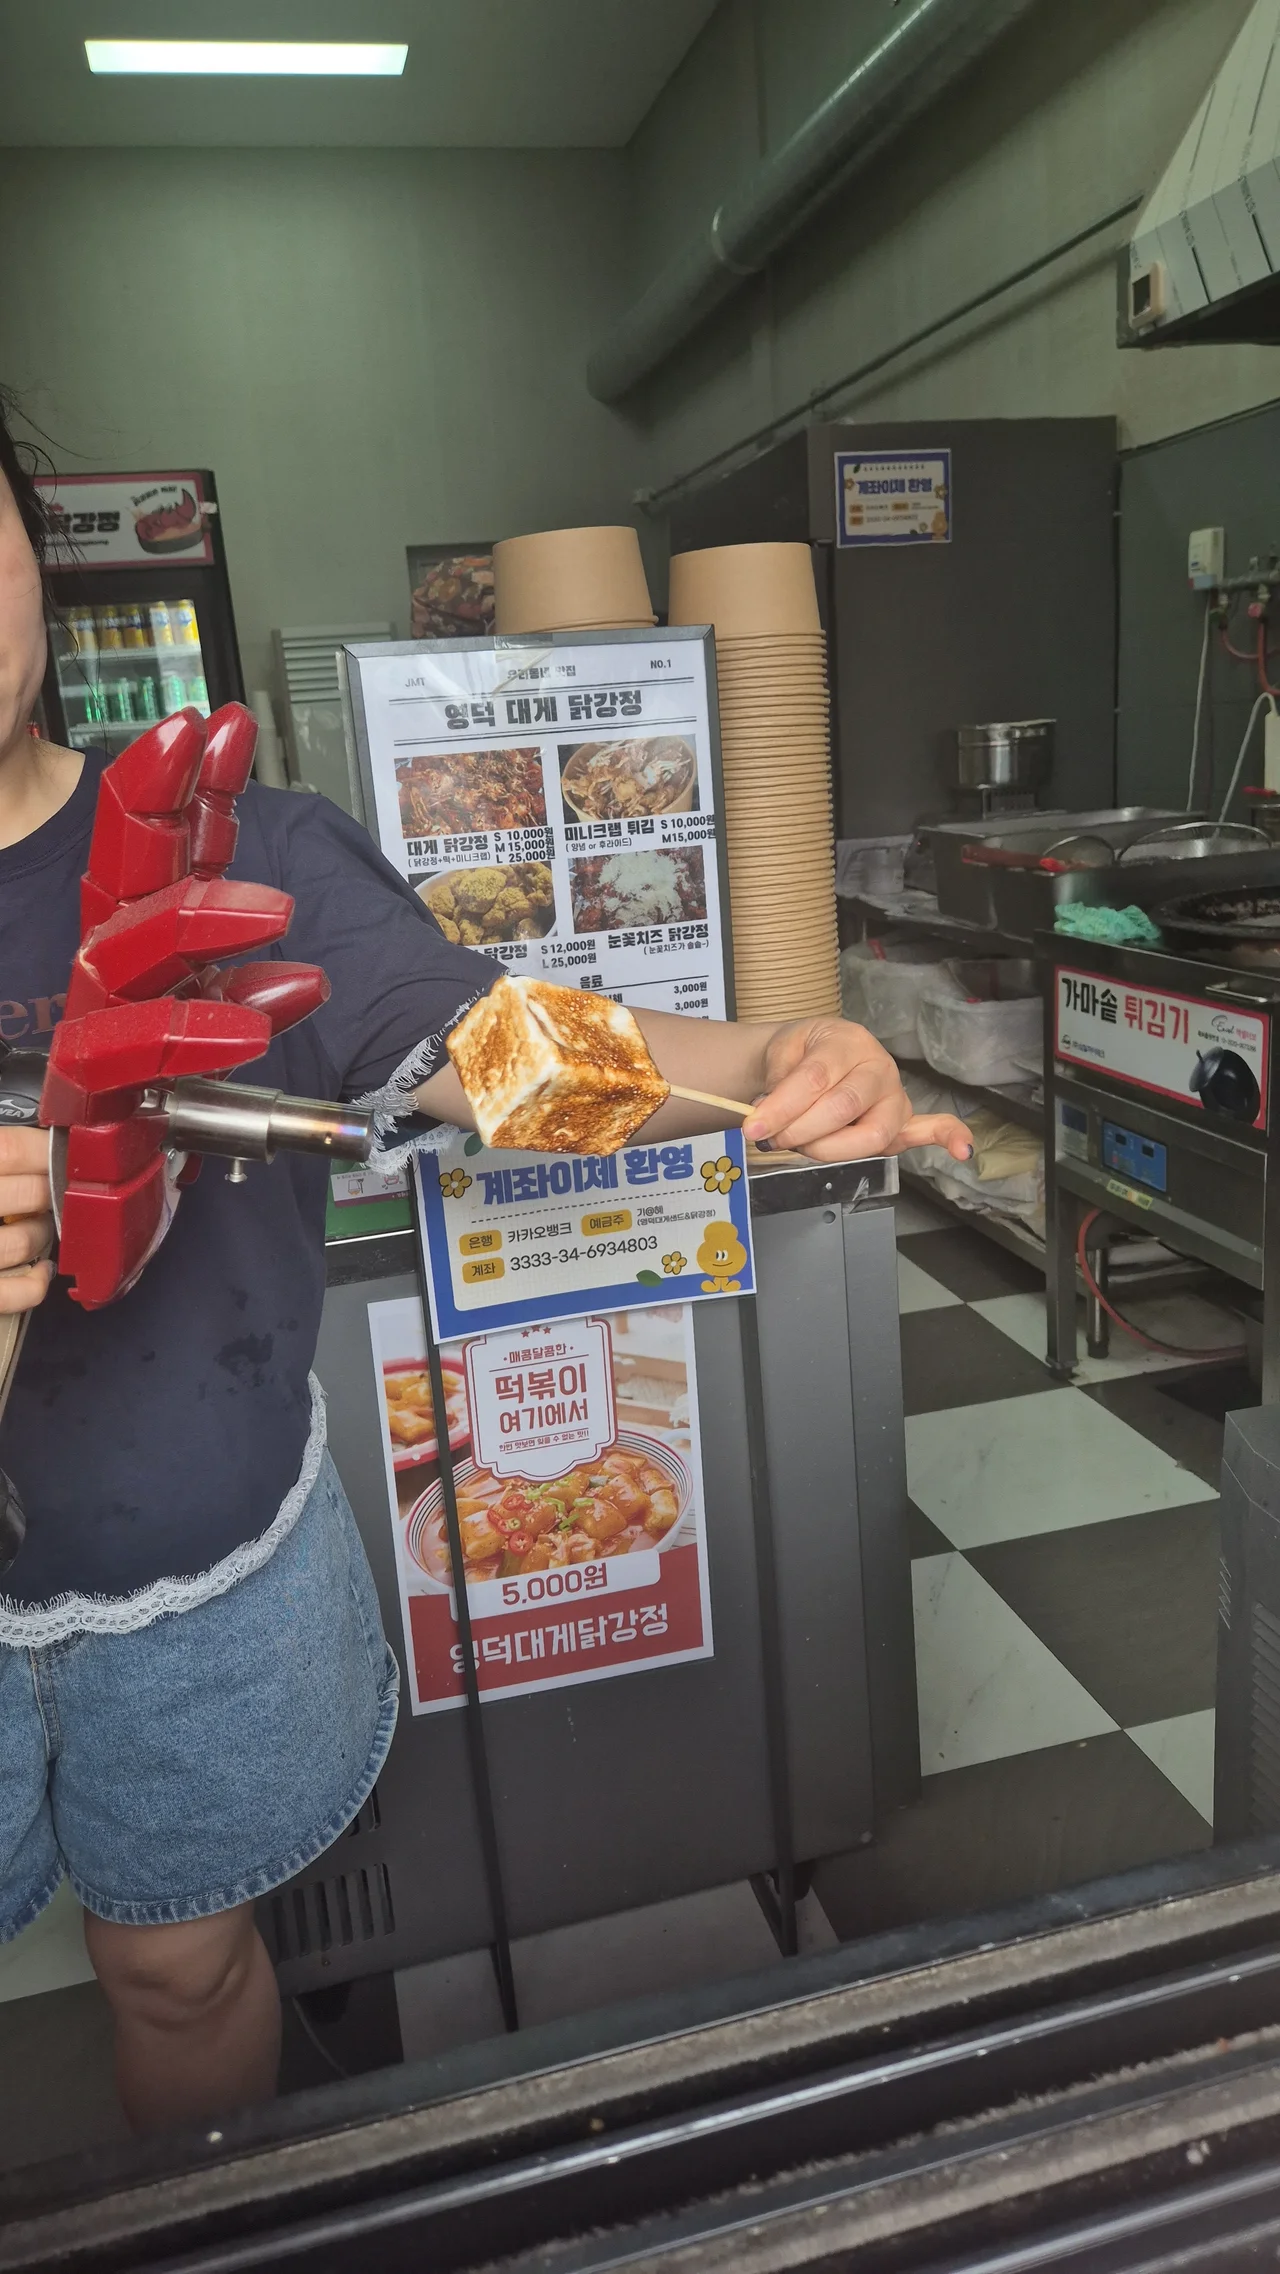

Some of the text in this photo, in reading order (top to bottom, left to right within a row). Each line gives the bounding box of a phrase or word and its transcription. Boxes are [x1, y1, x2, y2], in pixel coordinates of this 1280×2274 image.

[650, 659, 672, 669] NO.1
[404, 677, 425, 688] JMT
[444, 690, 643, 730] 영덕 대게 닭강정
[494, 827, 553, 842] S 10,000원
[564, 819, 654, 841] 미니크랩 튀김
[661, 820, 668, 829] S
[407, 835, 489, 856] 대게 닭강정
[496, 848, 556, 864] L 25,000원
[608, 923, 709, 949] 눈꽃치즈 닭강정
[541, 939, 596, 955] S 12,000원
[551, 952, 597, 968] 25,000원
[580, 974, 603, 989] 음료
[674, 981, 708, 995] 3,000원
[675, 998, 709, 1011] 3,000원
[1061, 977, 1118, 1024] 가마솥
[1124, 994, 1189, 1044] 튀김기
[477, 1143, 694, 1205] 계좌이체 환영
[468, 1214, 625, 1250] 은행 카카오뱅크 예금주
[471, 1235, 659, 1277] 계좌 3333-34-6934803
[508, 1343, 567, 1364] 매콤달콤한
[495, 1362, 587, 1404] 떡볶이
[499, 1398, 588, 1434] 여기에서
